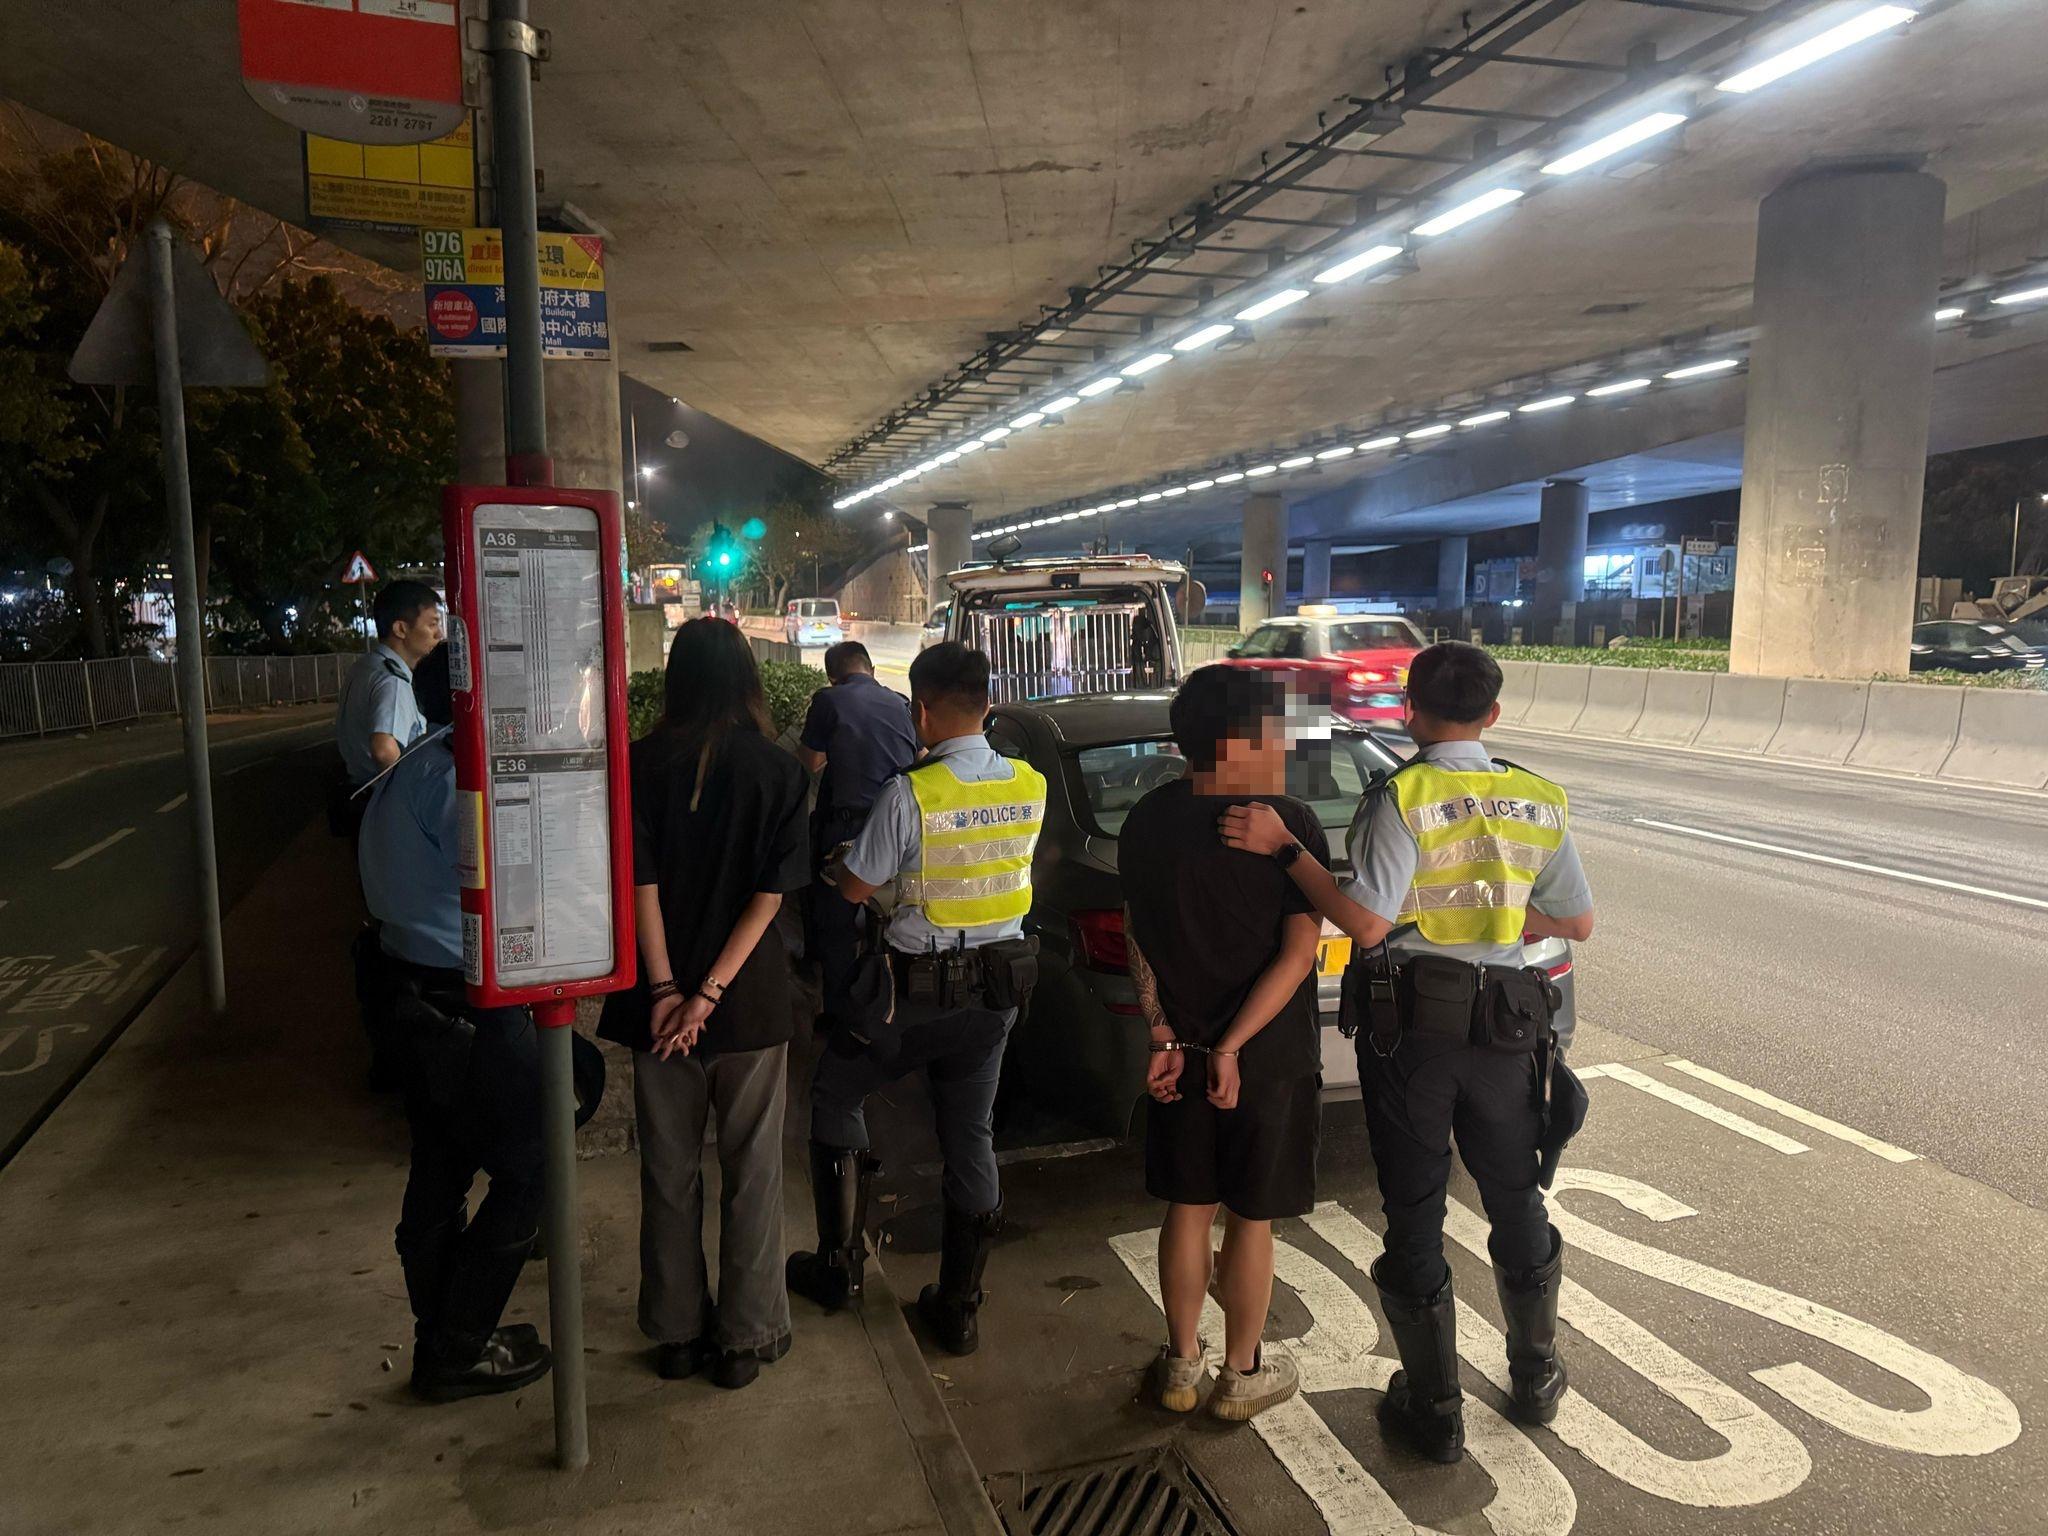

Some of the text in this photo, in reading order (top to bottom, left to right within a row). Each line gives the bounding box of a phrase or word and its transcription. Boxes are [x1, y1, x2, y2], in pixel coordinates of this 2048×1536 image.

[424, 231, 461, 254] 976
[425, 258, 465, 281] 976A
[467, 264, 492, 274] direct
[541, 267, 600, 280] Wan & Central
[545, 308, 576, 319] Building
[545, 338, 562, 346] Mall
[485, 532, 516, 546] A36
[497, 759, 527, 772] E36
[972, 806, 1017, 826] POLICE
[1022, 805, 1032, 819] 察
[1440, 797, 1537, 822] 警 PLICE 察
[1108, 1168, 2022, 1536] BUS
